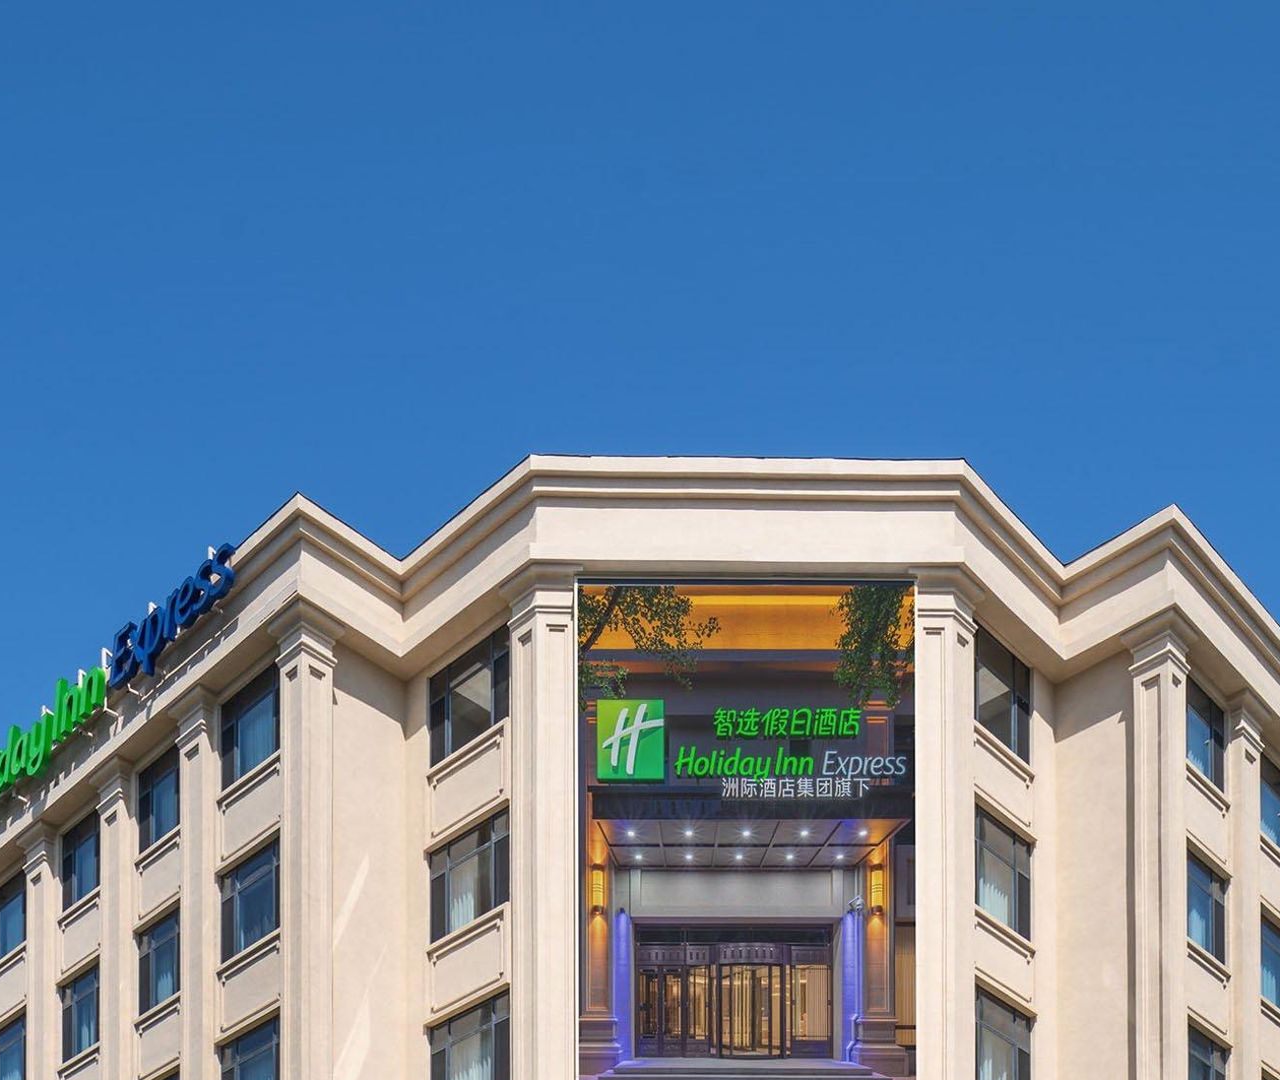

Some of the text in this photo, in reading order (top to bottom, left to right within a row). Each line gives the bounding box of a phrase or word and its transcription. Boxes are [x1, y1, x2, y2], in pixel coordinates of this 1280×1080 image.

[52, 666, 107, 744] Inn
[108, 542, 236, 689] Express
[713, 706, 863, 737] 智选假日酒店
[673, 746, 907, 780] Holiday Inn Express
[721, 777, 870, 798] 洲际酒店集团旗下
